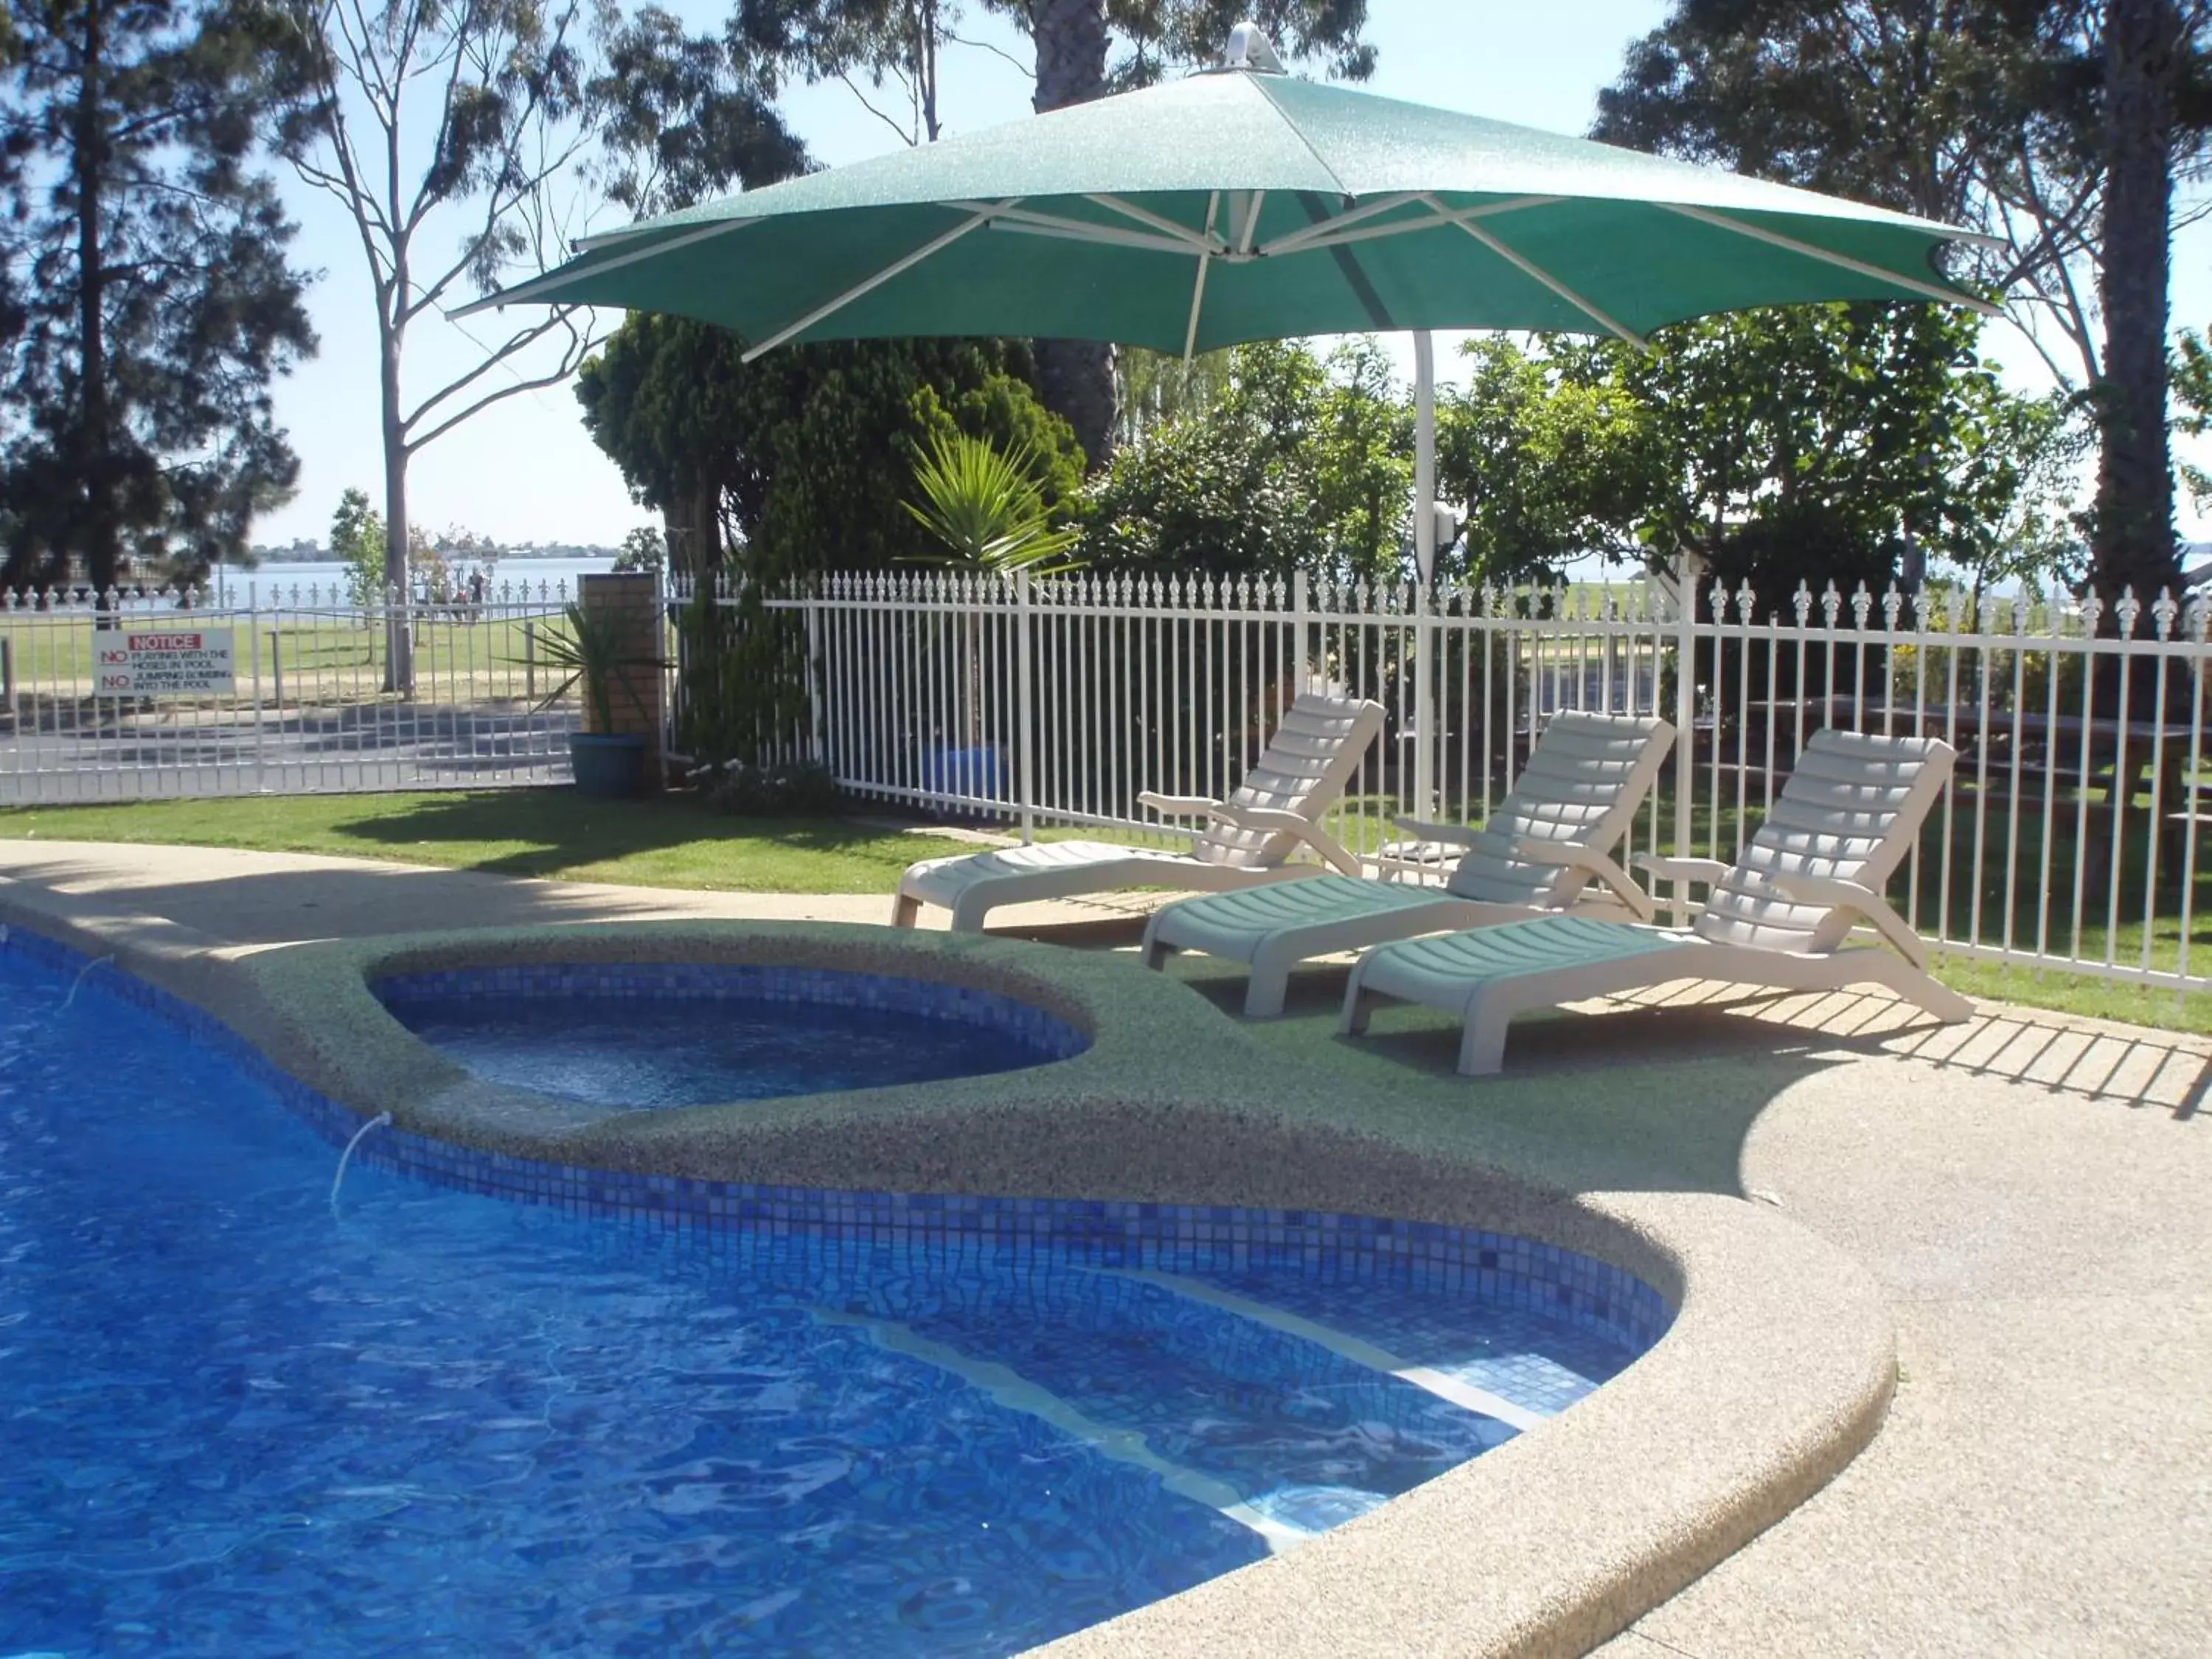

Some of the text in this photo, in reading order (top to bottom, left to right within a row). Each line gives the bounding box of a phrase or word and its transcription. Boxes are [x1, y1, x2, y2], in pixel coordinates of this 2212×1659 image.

[134, 636, 194, 649] NOTICE
[100, 650, 229, 662] NO PLAYING WITH THE
[132, 661, 167, 669] HOSES
[184, 661, 215, 669] POOL
[102, 675, 130, 686] NO
[134, 672, 183, 681] JUMPING
[134, 681, 210, 690] INTO THE POOL
